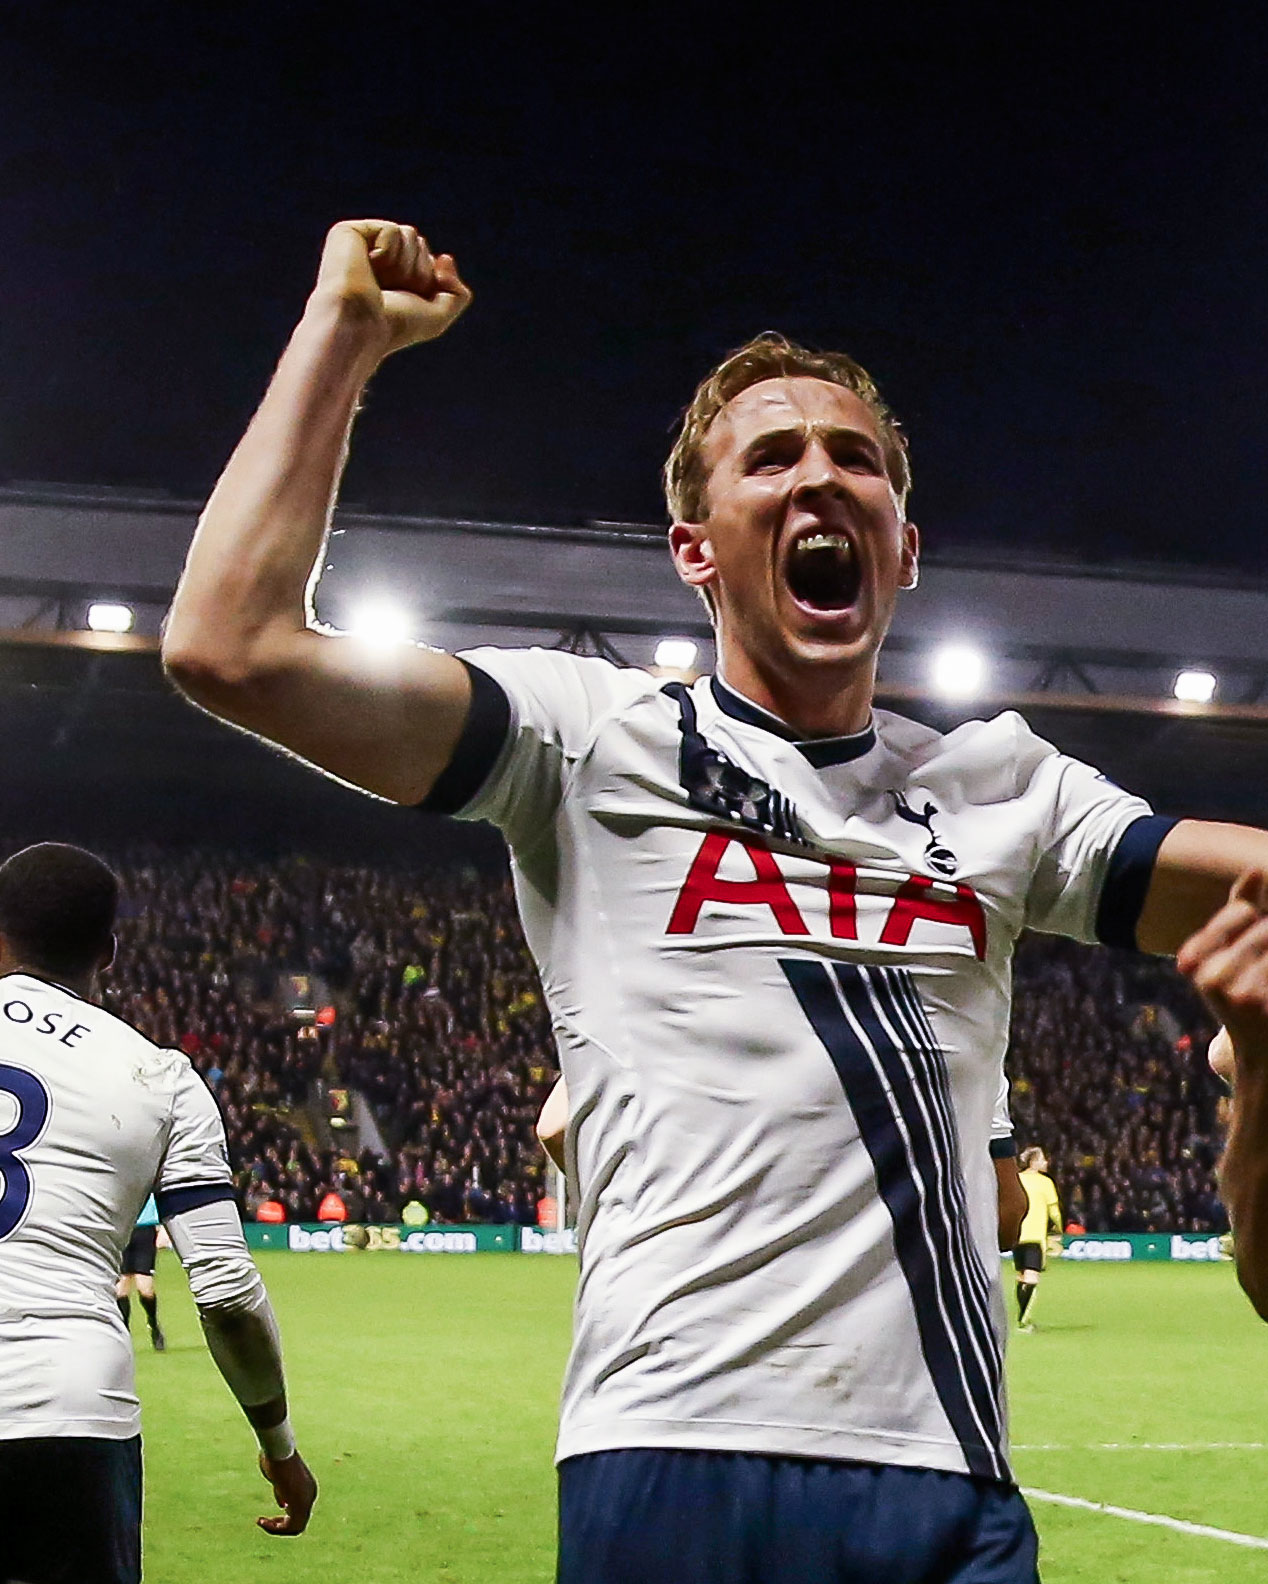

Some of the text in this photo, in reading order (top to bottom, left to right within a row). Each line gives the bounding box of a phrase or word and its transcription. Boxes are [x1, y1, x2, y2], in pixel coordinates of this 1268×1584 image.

[665, 826, 987, 962] AIA
[3, 1000, 91, 1048] OSE
[520, 1226, 578, 1252] bet
